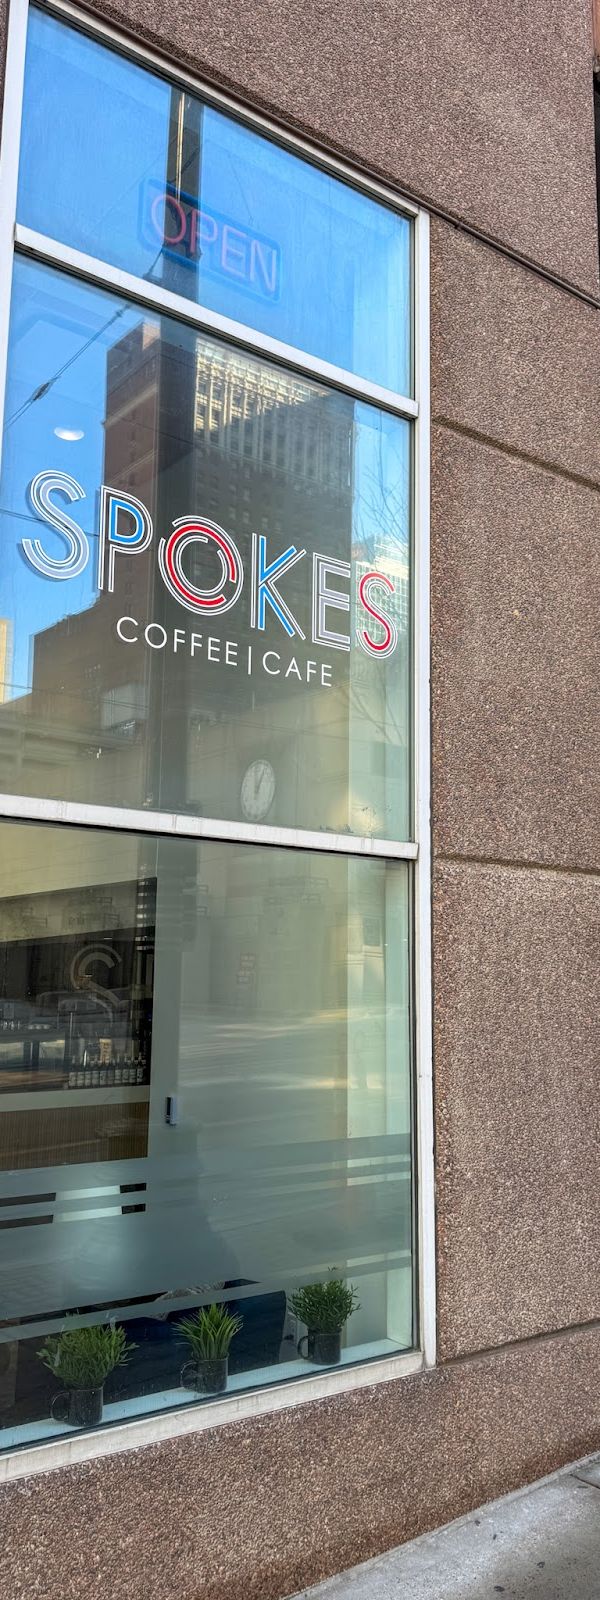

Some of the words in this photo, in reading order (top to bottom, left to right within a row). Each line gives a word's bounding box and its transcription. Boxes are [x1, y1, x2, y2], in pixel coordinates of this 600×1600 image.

[150, 193, 278, 293] OPEN
[22, 470, 399, 659] SPOKES
[116, 616, 238, 666] COFFEE
[262, 651, 333, 687] CAFE
